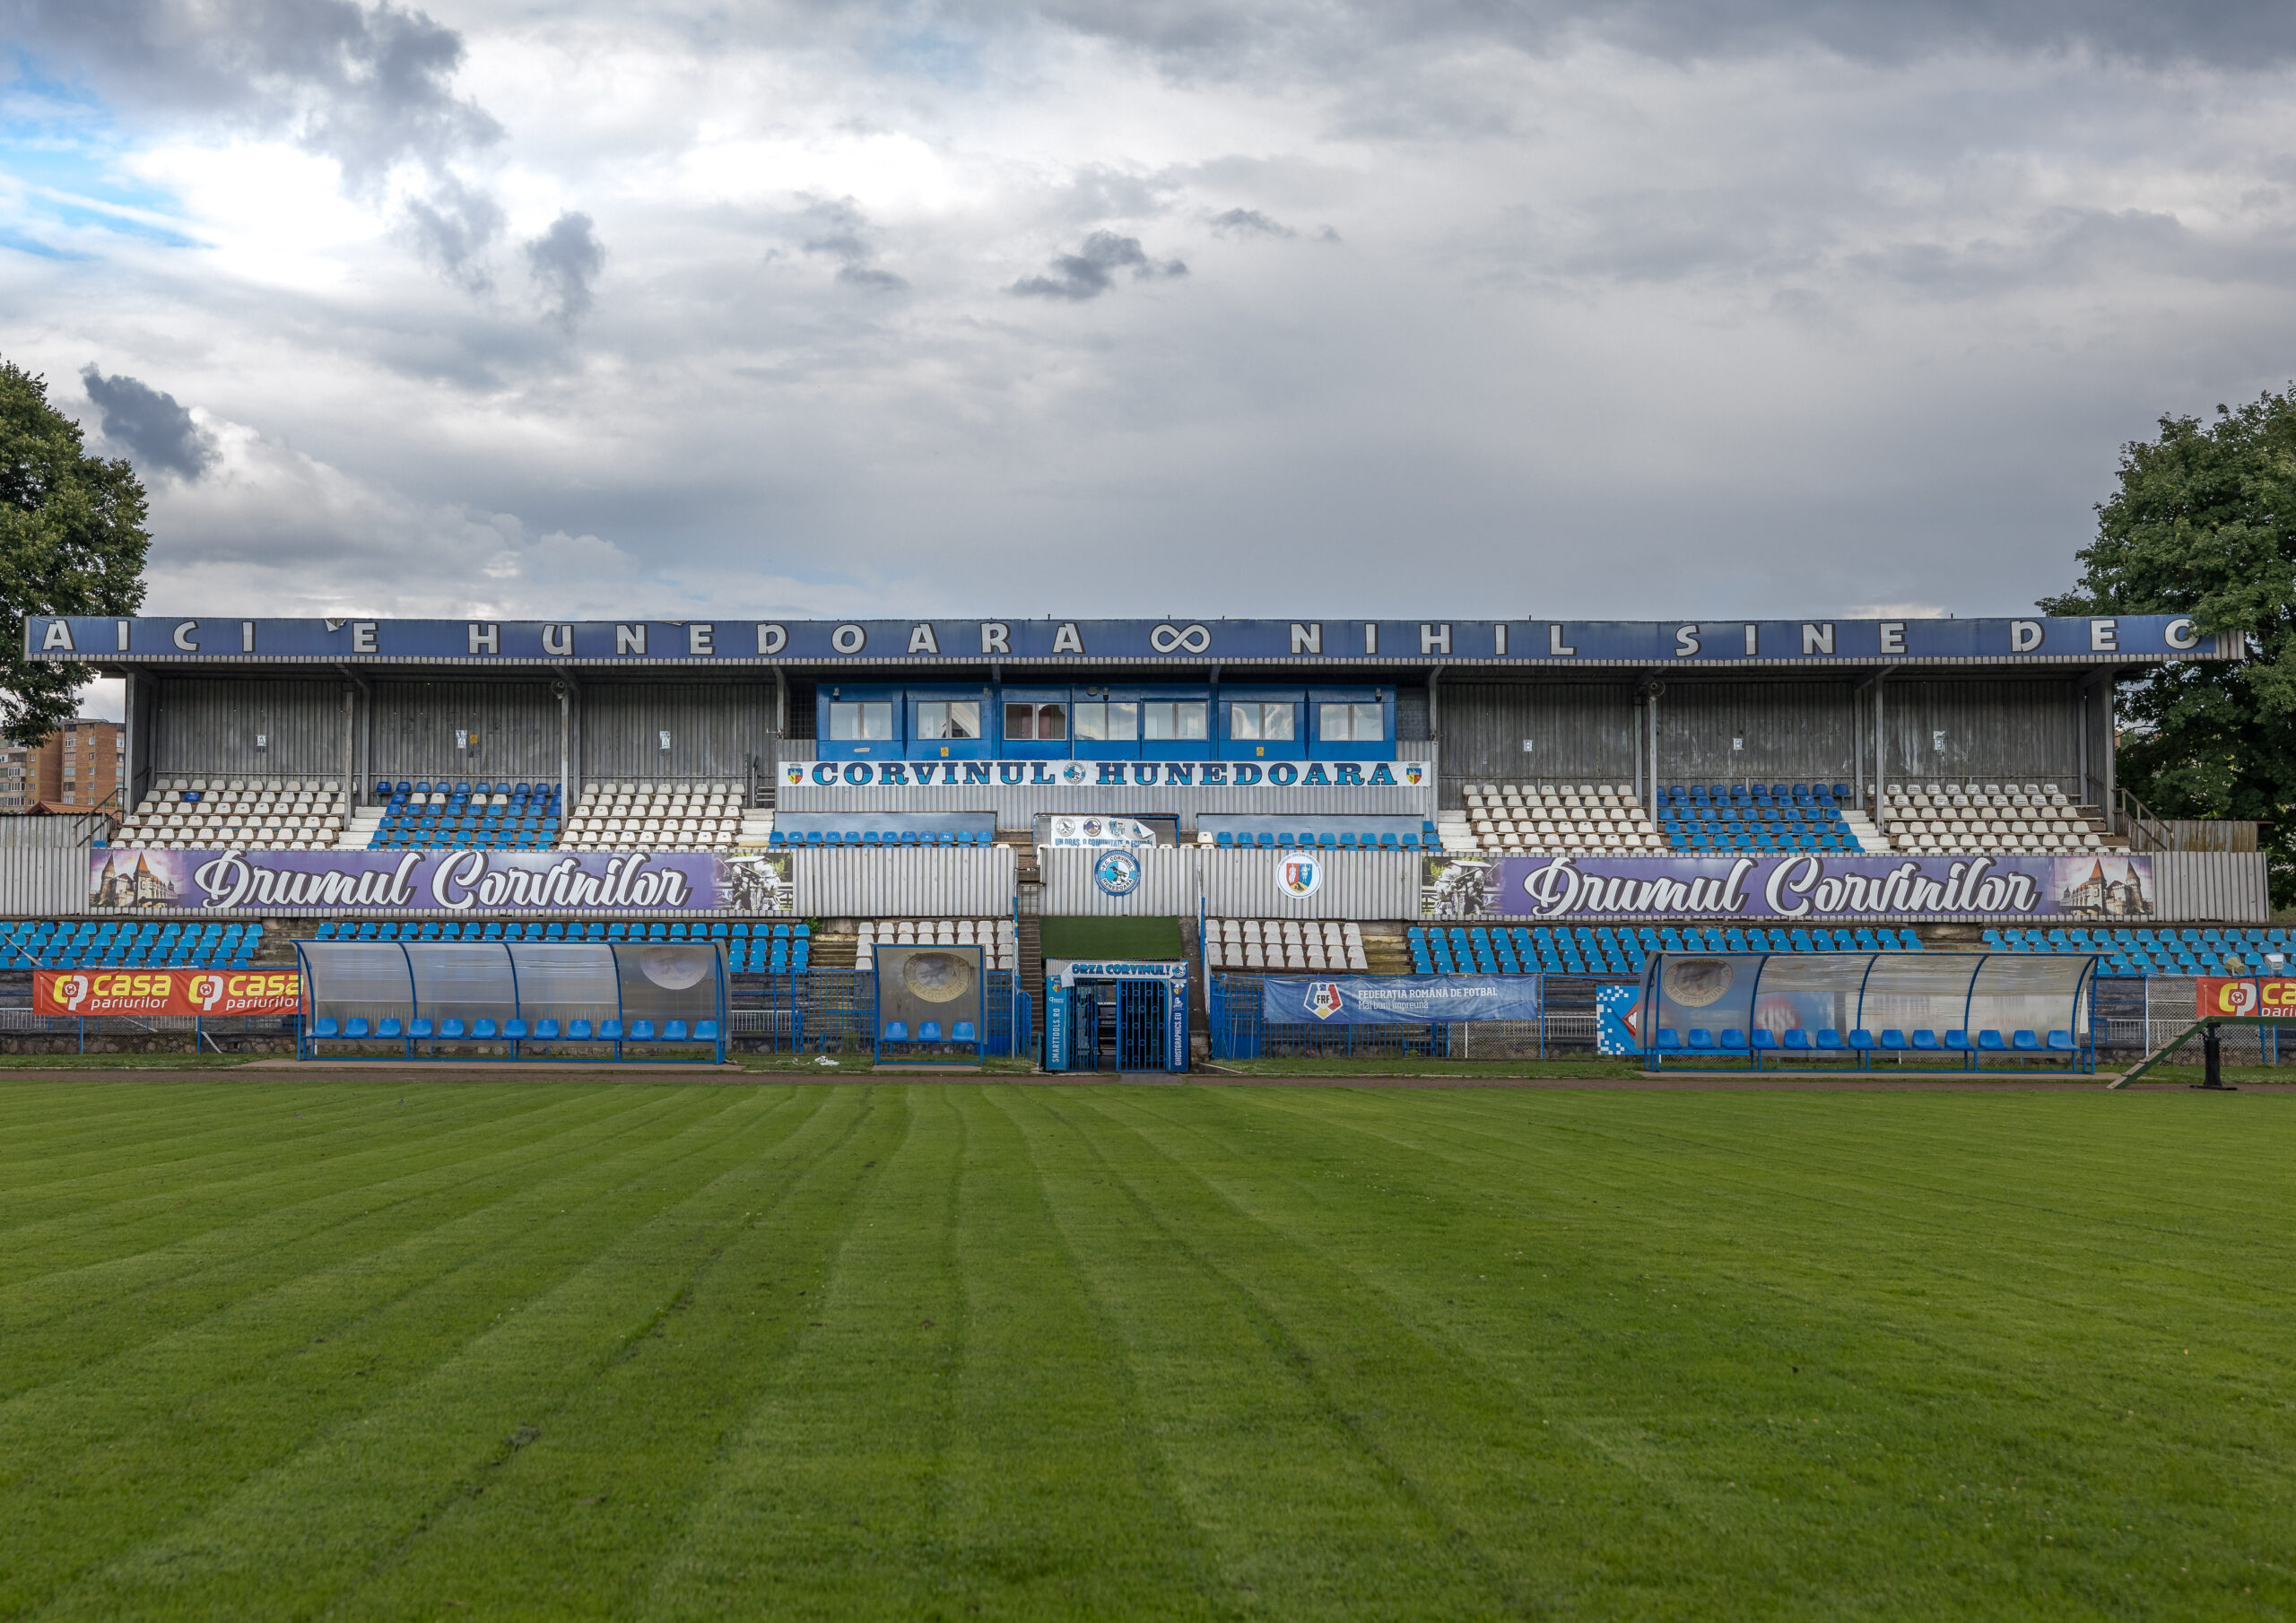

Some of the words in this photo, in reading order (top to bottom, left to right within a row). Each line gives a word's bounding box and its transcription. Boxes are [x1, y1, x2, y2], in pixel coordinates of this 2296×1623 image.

[42, 619, 257, 653] AICI
[352, 621, 380, 654] E
[466, 622, 1085, 655] HUNEDOARA
[1290, 622, 1578, 656] NIHIL
[1674, 621, 1909, 657] SINE
[812, 762, 1055, 786] CORVINUL
[1095, 762, 1397, 785] HUNEDOARA
[194, 850, 426, 909] Drumul
[430, 850, 694, 910] Corvinilor
[1103, 879, 1133, 890] HUNEDOARA
[1524, 856, 1759, 916] Drumul
[1764, 856, 2042, 916] Corvinilor
[1106, 964, 1170, 975] CORVINUL!
[91, 996, 169, 1011] pariurilor
[1317, 994, 1330, 1004] FRF
[1451, 988, 1462, 997] DE
[1464, 987, 1498, 997] FOTBAL
[1358, 1000, 1372, 1010] Mai
[1374, 1000, 1390, 1009] buni
[1052, 1008, 1060, 1063] SMARTTOOLS.RO
[1174, 1012, 1182, 1066] GHOSTGRAPHICS.EU
